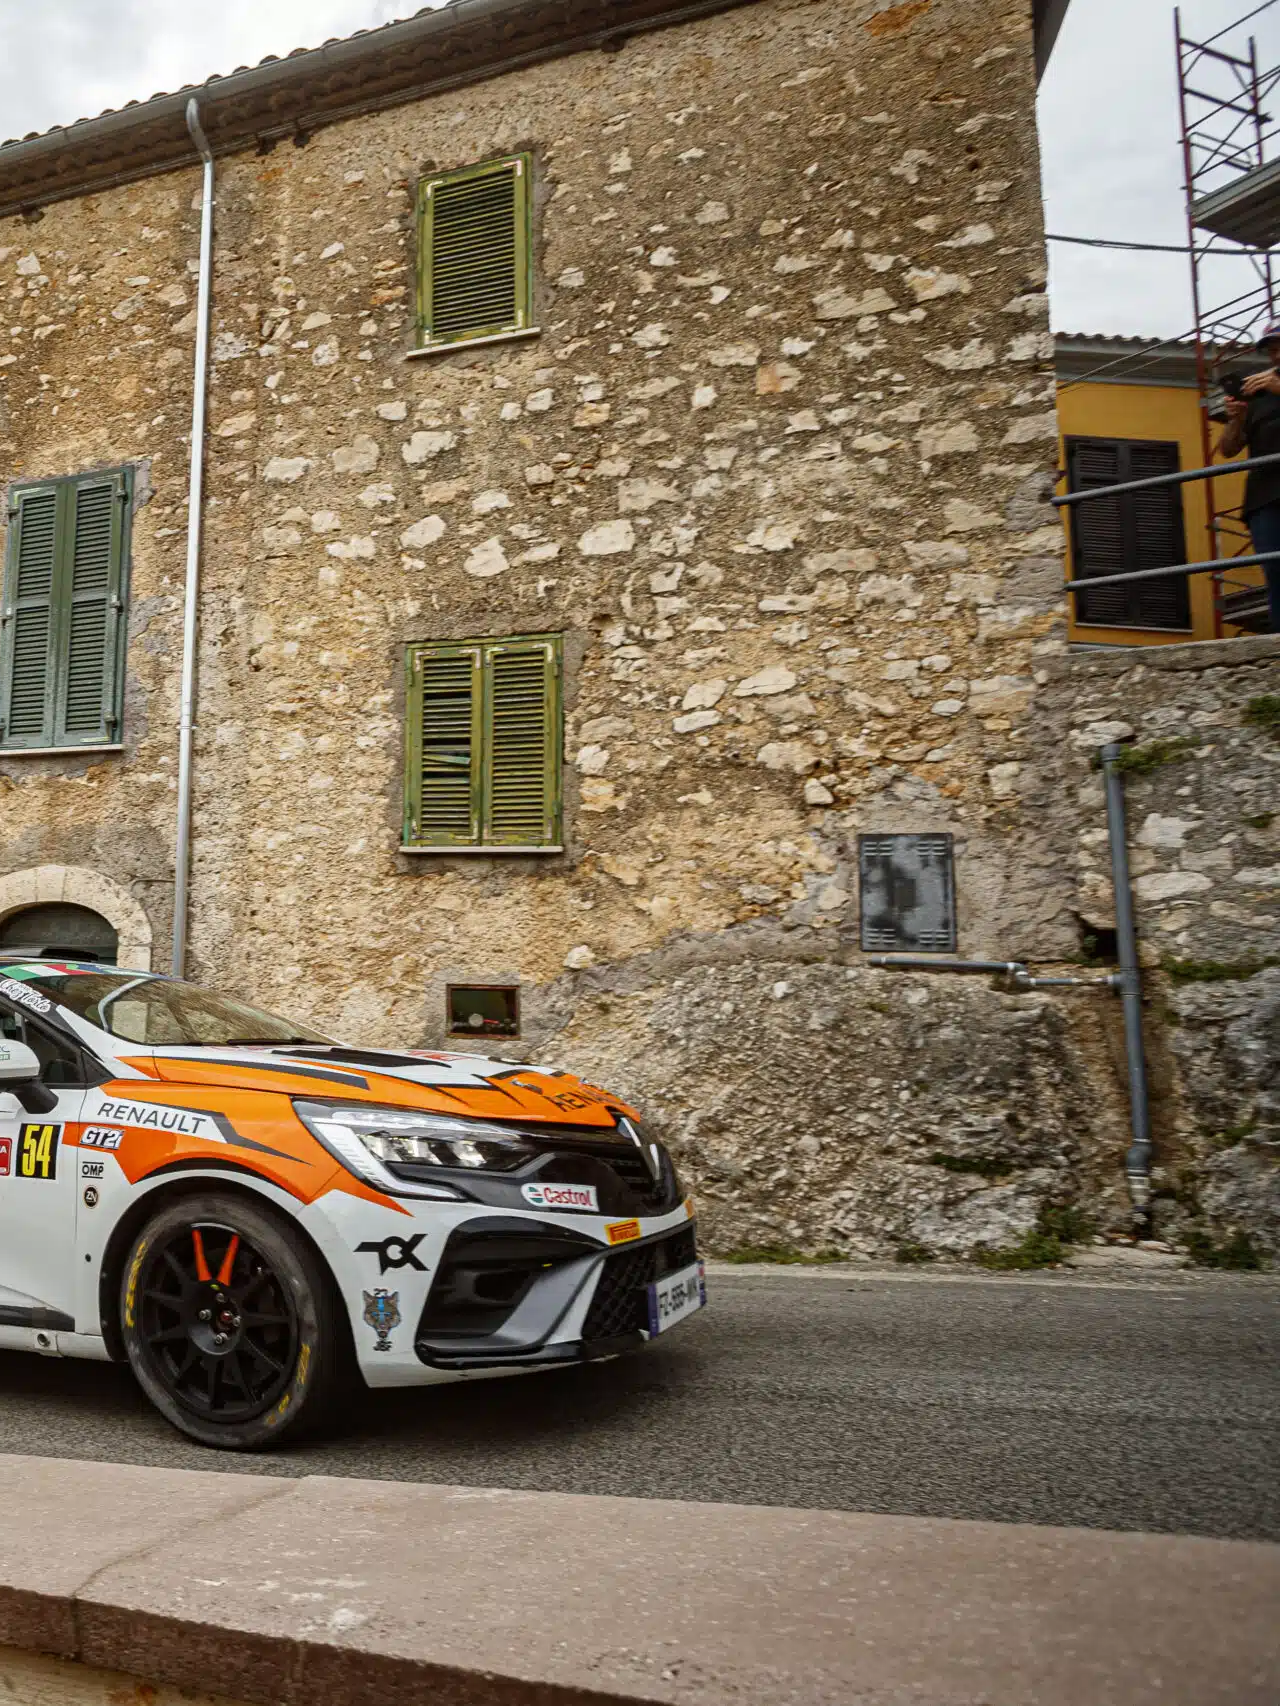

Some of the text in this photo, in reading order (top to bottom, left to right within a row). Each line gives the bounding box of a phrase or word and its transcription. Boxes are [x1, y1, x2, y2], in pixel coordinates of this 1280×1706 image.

[97, 1102, 206, 1134] RENAULT
[22, 1124, 53, 1177] 54
[82, 1164, 103, 1176] OMP
[543, 1187, 593, 1207] Castrol
